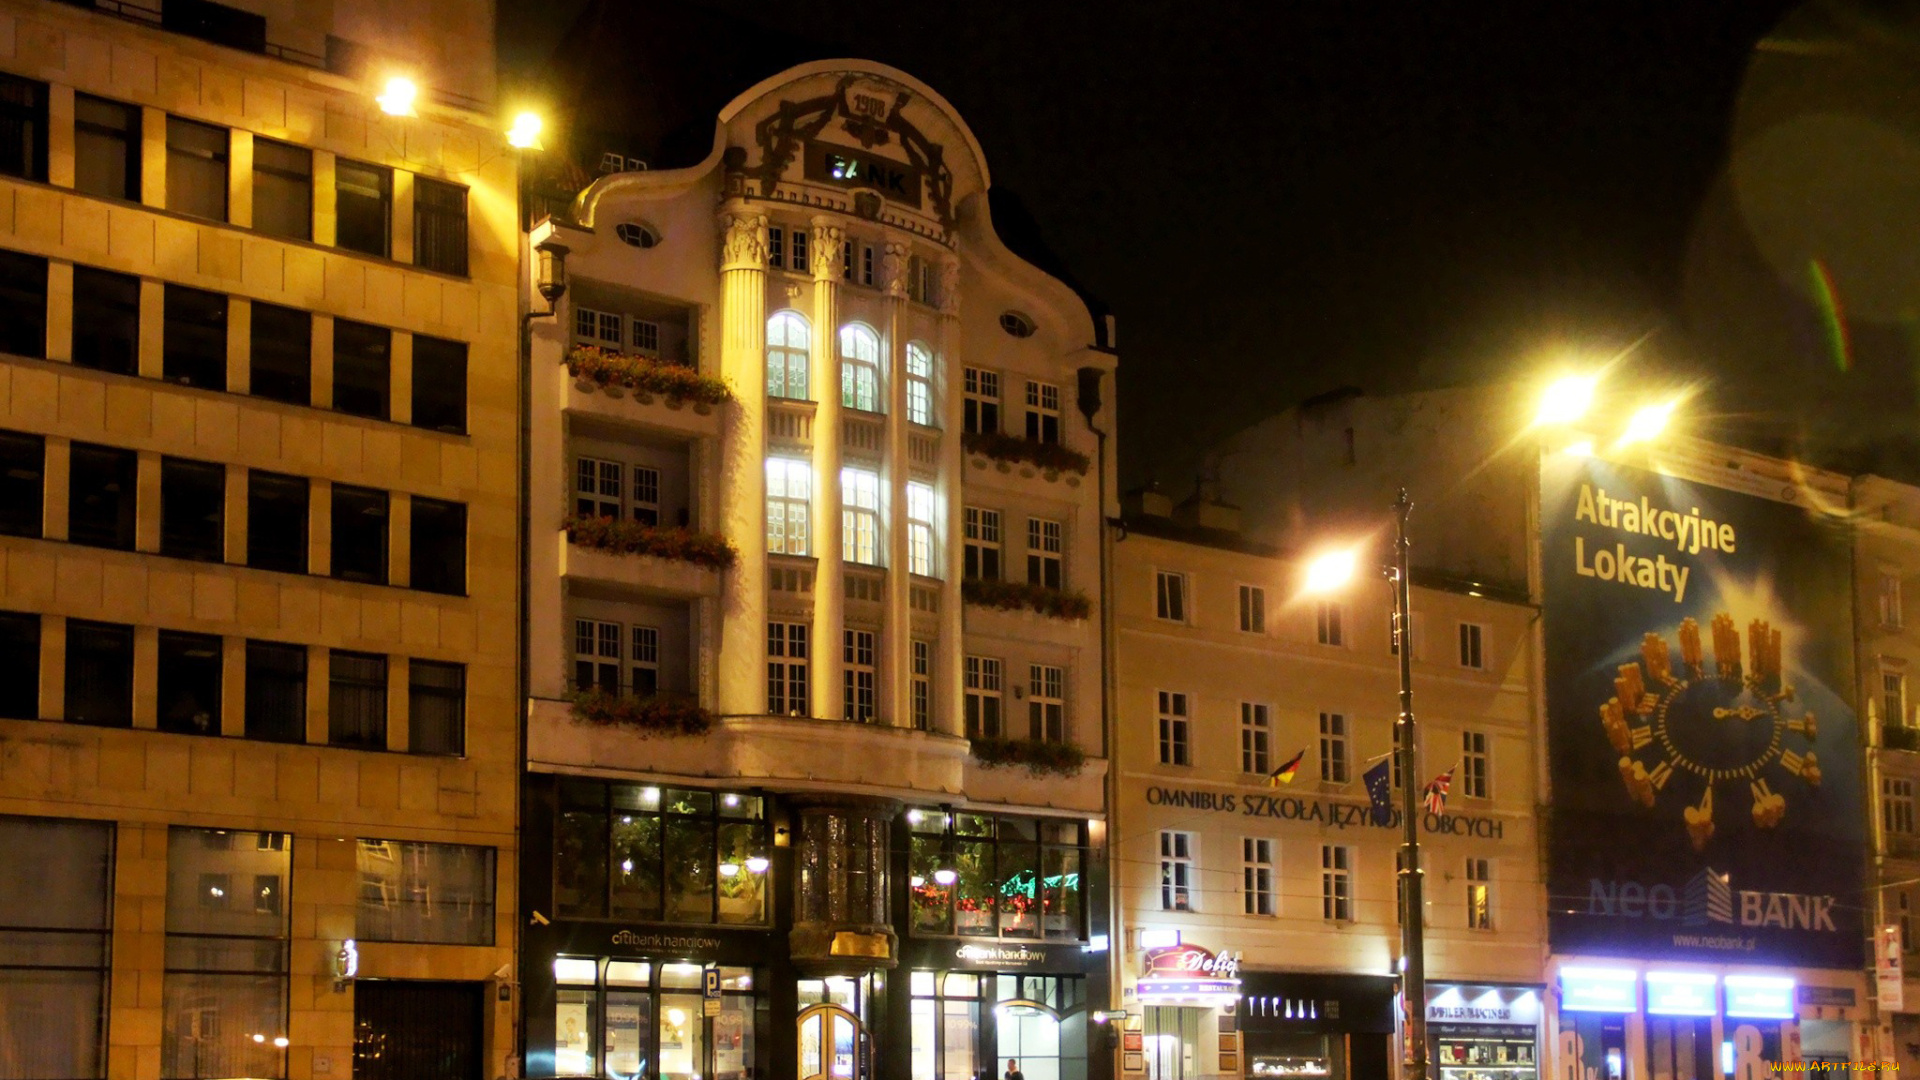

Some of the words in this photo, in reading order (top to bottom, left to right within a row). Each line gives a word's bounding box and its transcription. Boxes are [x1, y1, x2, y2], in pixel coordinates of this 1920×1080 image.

[853, 94, 886, 118] 1908
[1575, 484, 1736, 555] Atrakcyjne
[1575, 537, 1690, 603] Lokaty
[1146, 786, 1236, 813] OMNIBUS
[1242, 794, 1323, 823] SZKOŁA
[1423, 814, 1503, 839] OBCYCH
[1740, 890, 1837, 932] BANK
[611, 929, 662, 947] citibank
[1673, 933, 1756, 953] www.neobank.pl
[998, 946, 1046, 963] handlowy
[706, 971, 717, 996] P
